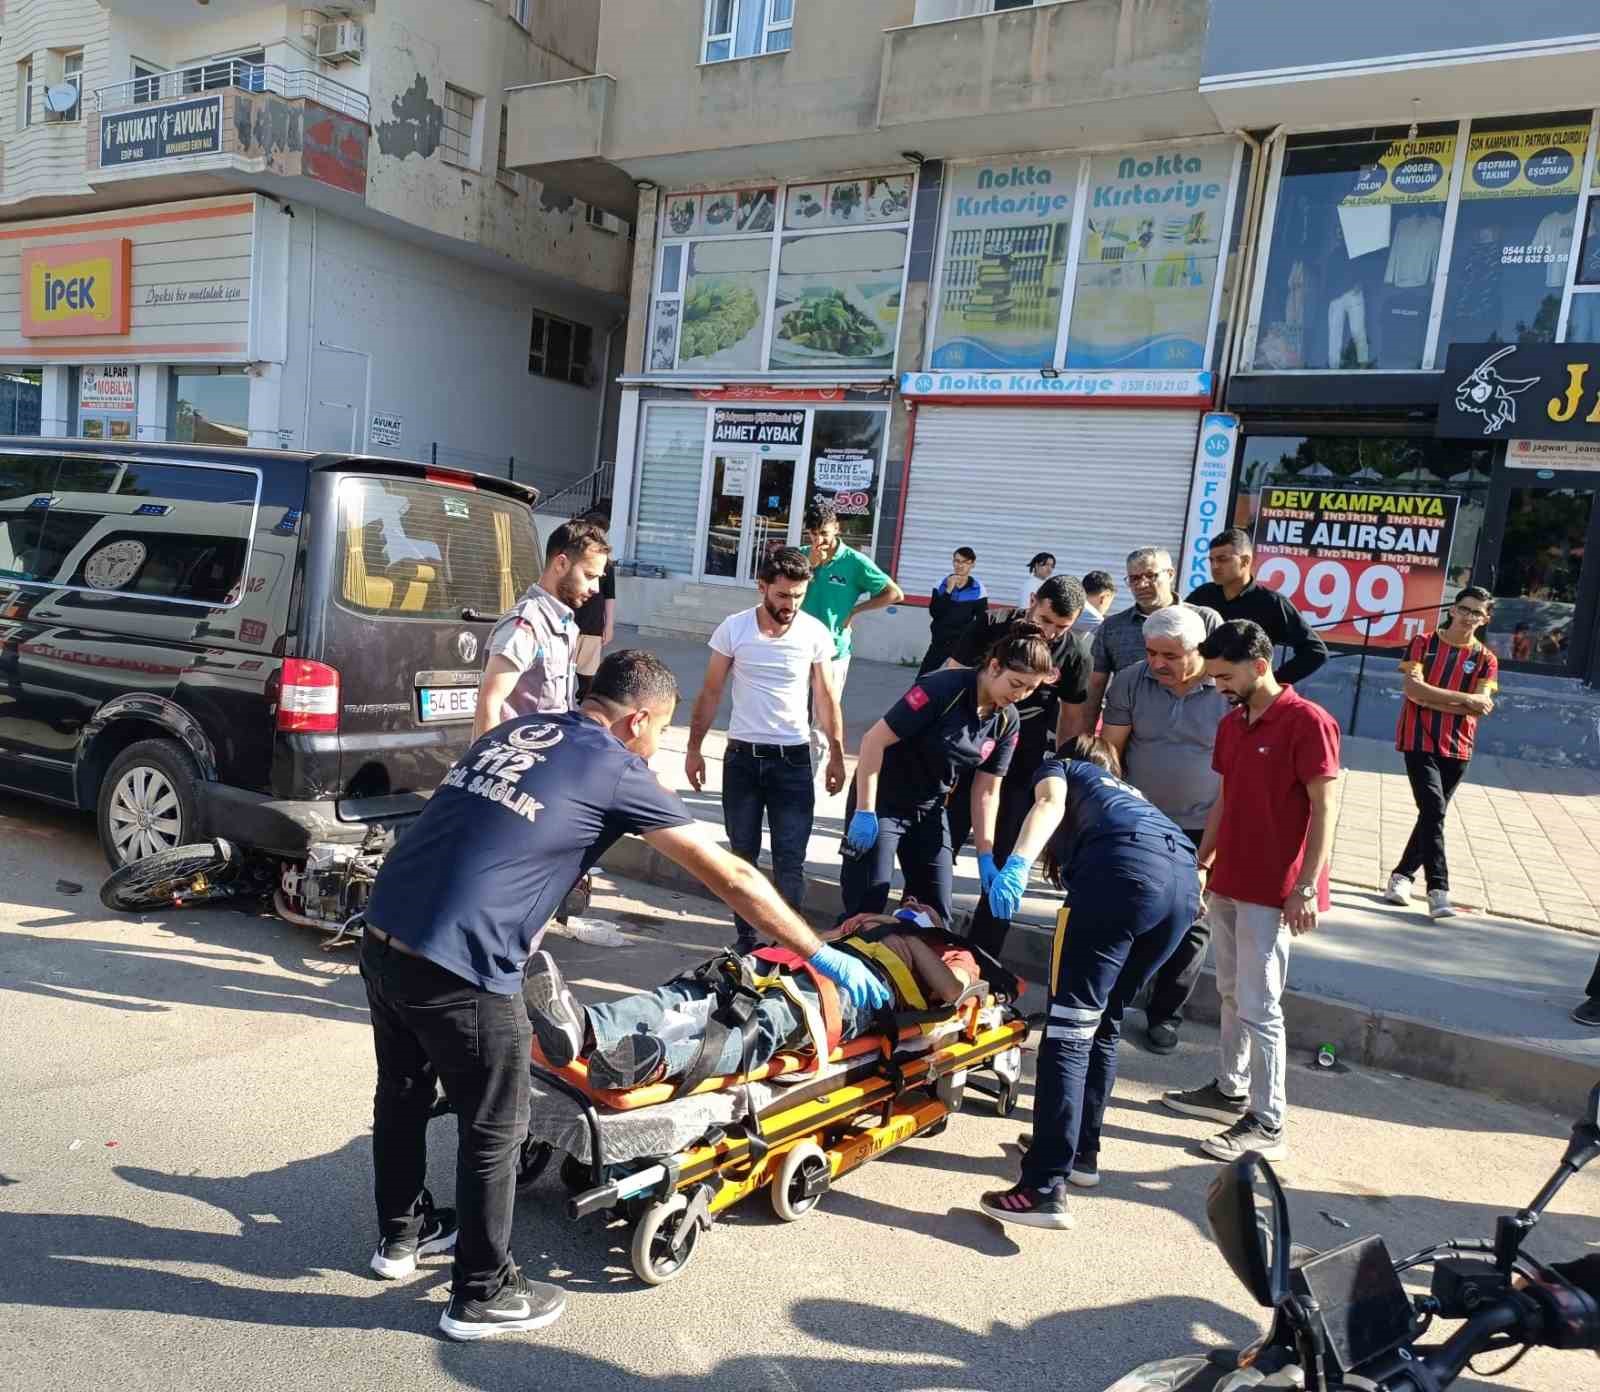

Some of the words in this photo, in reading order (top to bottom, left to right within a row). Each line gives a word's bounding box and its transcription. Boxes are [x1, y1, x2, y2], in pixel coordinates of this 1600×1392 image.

[117, 116, 158, 144] AVUKAT
[173, 105, 218, 136] AVUKAT
[1525, 132, 1551, 146] PATRON
[1118, 154, 1202, 180] Nokta
[1542, 155, 1559, 165] ALT
[977, 165, 1052, 189] Nokta
[957, 192, 1069, 217] Kırtasiye
[1093, 180, 1221, 209] Kırtasiye
[104, 367, 128, 377] ALPAR
[938, 374, 1003, 391] Nokta
[374, 417, 401, 430] AVUKAT
[715, 425, 756, 441] AHMET
[757, 426, 799, 442] AYBAK
[1270, 490, 1314, 508] DEV
[1319, 492, 1444, 516] KAMPANYA
[1266, 519, 1305, 544] NE
[1310, 522, 1440, 553] ALIRSAN
[430, 693, 445, 712] 54
[450, 691, 469, 710] BE
[473, 746, 536, 783] 112
[467, 776, 545, 823] SAĞLIK
